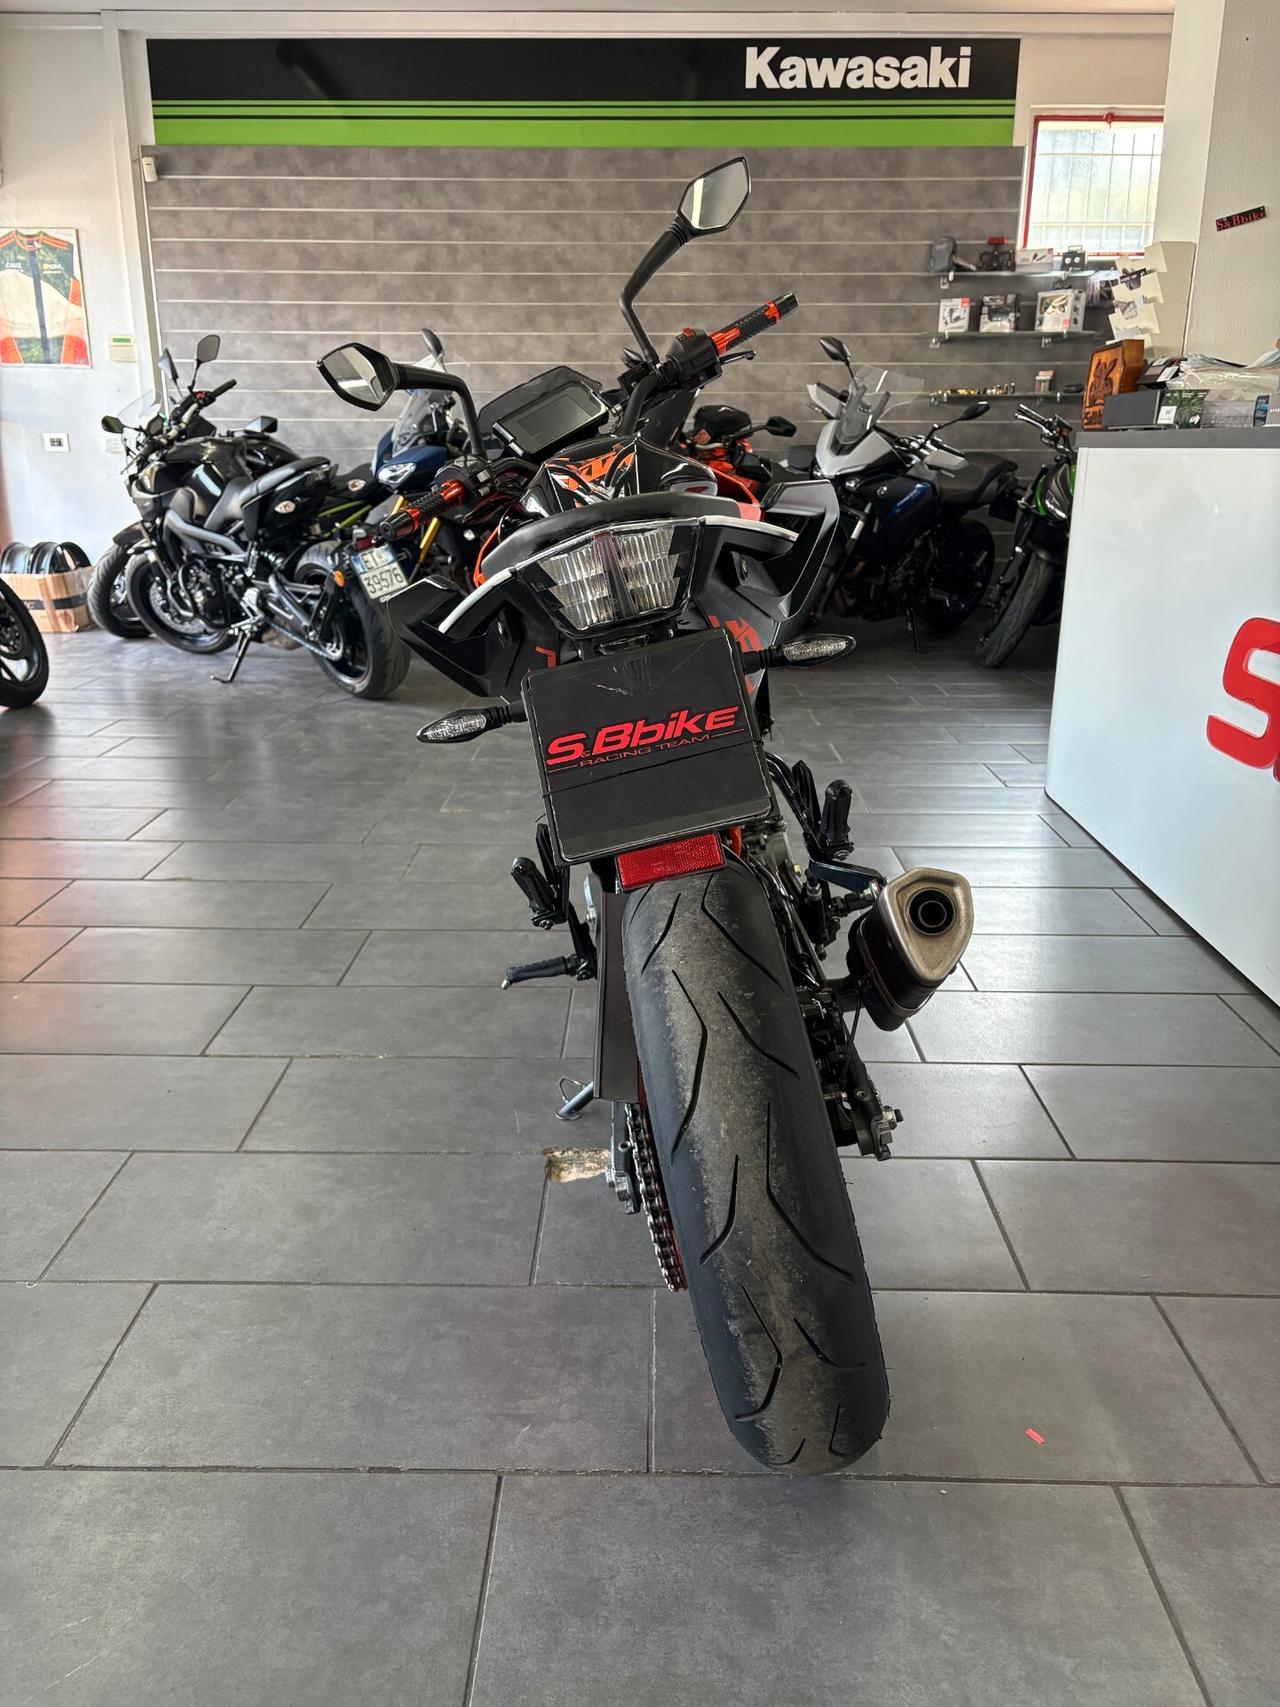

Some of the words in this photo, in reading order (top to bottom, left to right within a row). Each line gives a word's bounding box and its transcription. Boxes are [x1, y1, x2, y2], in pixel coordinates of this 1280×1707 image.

[745, 46, 972, 89] Kawasaki
[361, 550, 379, 569] ET
[364, 567, 404, 594] 39576
[579, 748, 652, 767] RACING
[655, 734, 711, 750] TEAM
